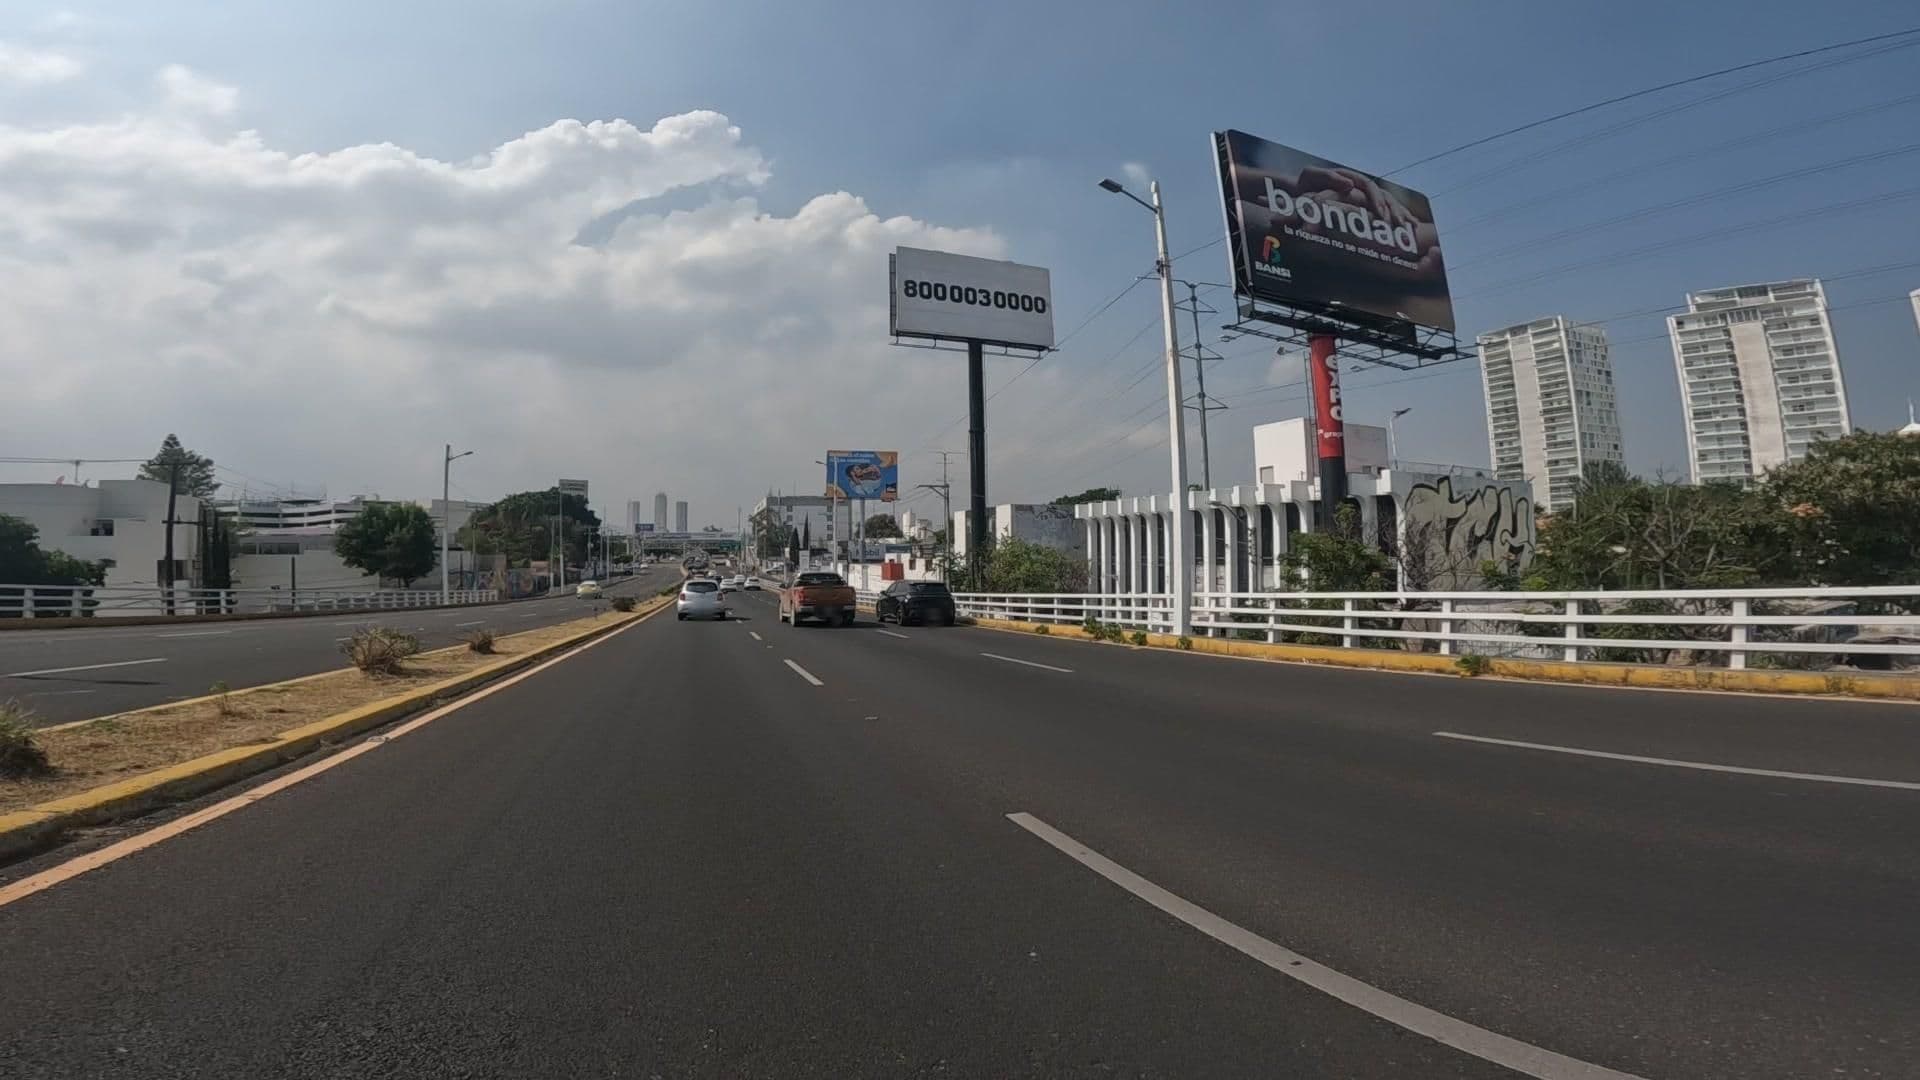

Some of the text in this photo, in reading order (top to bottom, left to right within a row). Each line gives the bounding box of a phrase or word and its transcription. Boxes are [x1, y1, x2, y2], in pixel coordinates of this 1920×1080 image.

[1263, 177, 1418, 254] bondad
[1284, 224, 1294, 235] la
[1295, 228, 1330, 245] riqueza
[1331, 239, 1344, 249] no
[1345, 243, 1356, 252] se
[1357, 246, 1379, 259] mide
[1380, 253, 1392, 262] en
